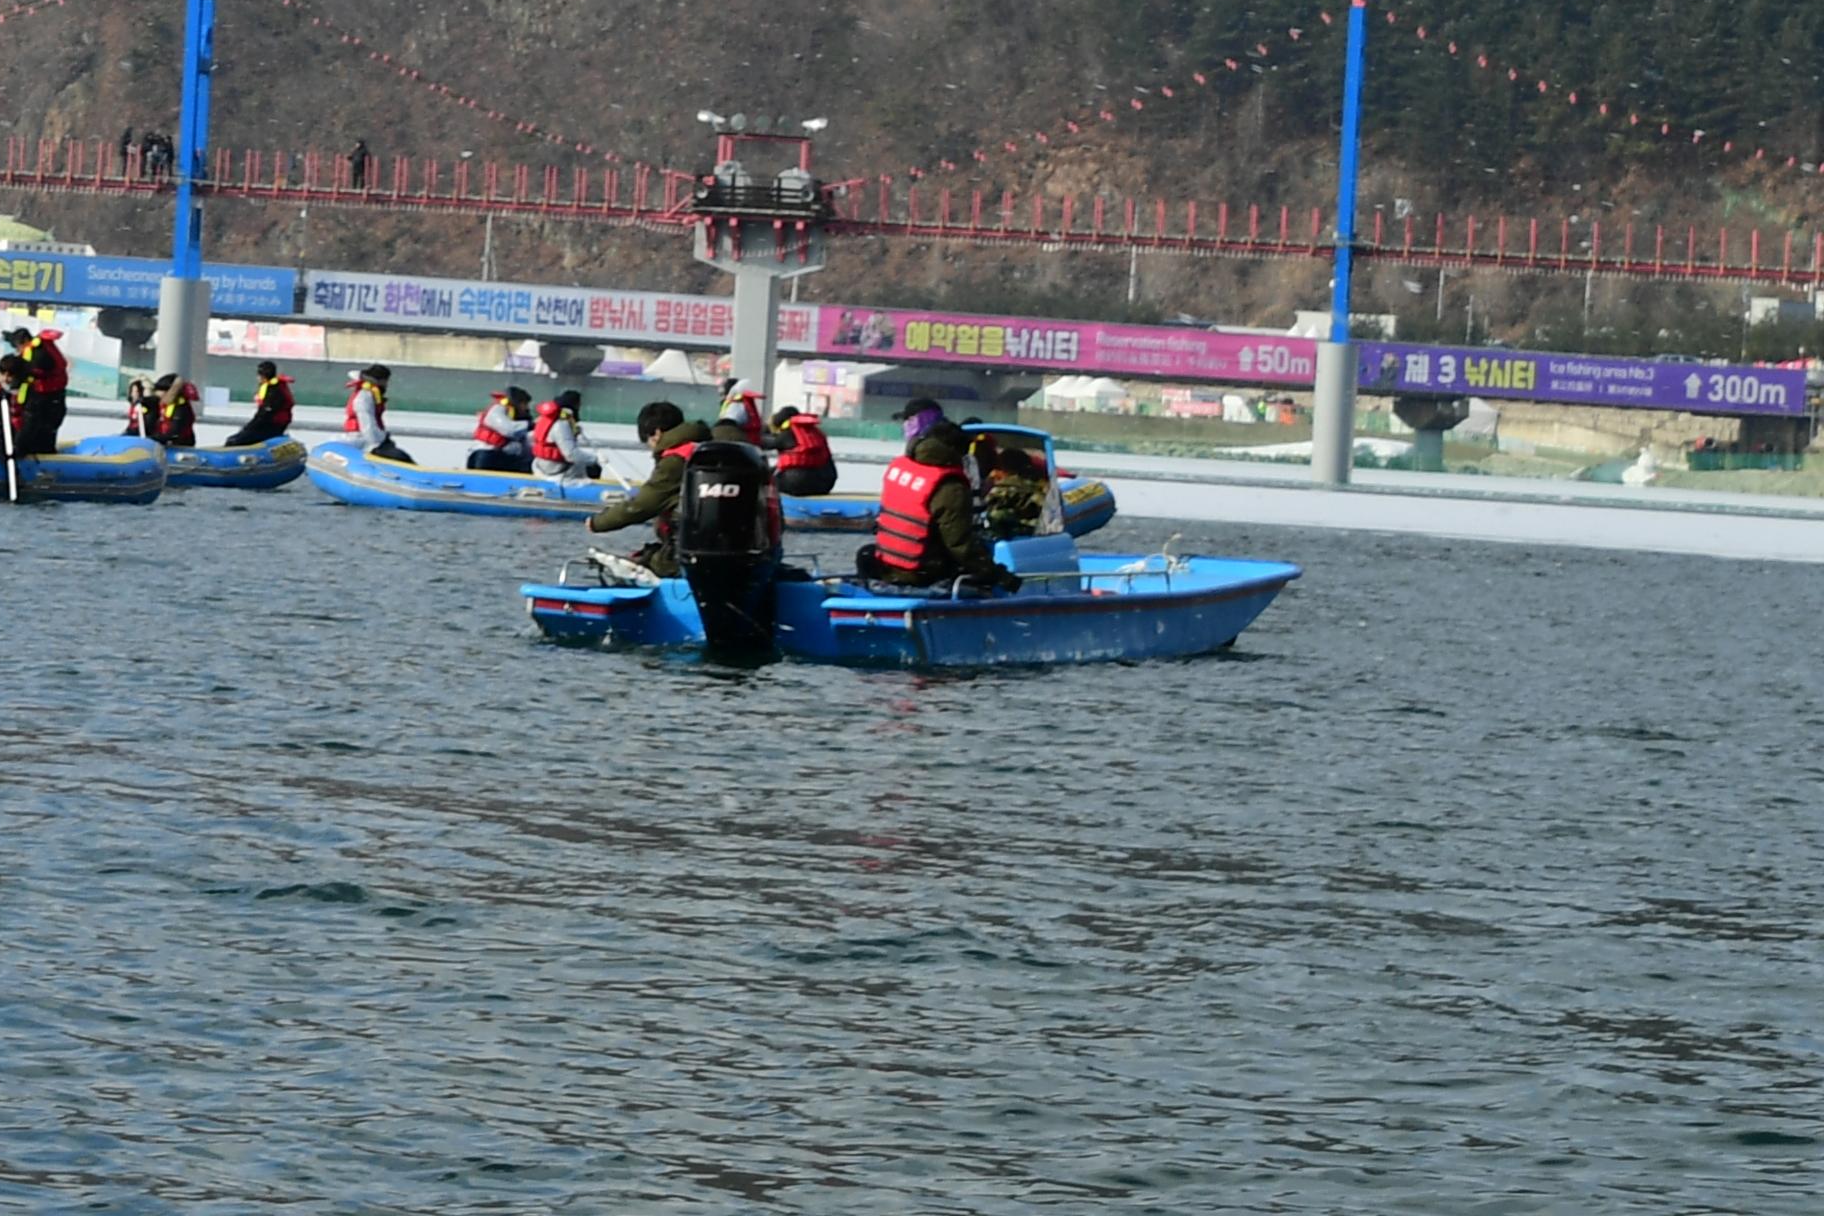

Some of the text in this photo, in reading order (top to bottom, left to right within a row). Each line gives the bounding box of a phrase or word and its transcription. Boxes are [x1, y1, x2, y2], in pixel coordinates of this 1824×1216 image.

[314, 280, 379, 313] 축제기간
[383, 280, 453, 318] 화천에서
[458, 287, 532, 325] 숙박하면
[536, 294, 585, 327] 산천어
[905, 320, 1080, 361] 예약얼음낚시터
[1257, 344, 1312, 375] 50m
[1437, 354, 1456, 384] 3
[1464, 356, 1537, 391] 낚시터
[1566, 362, 1602, 380] fishing
[1707, 374, 1787, 405] 300m
[697, 483, 741, 499] 140
